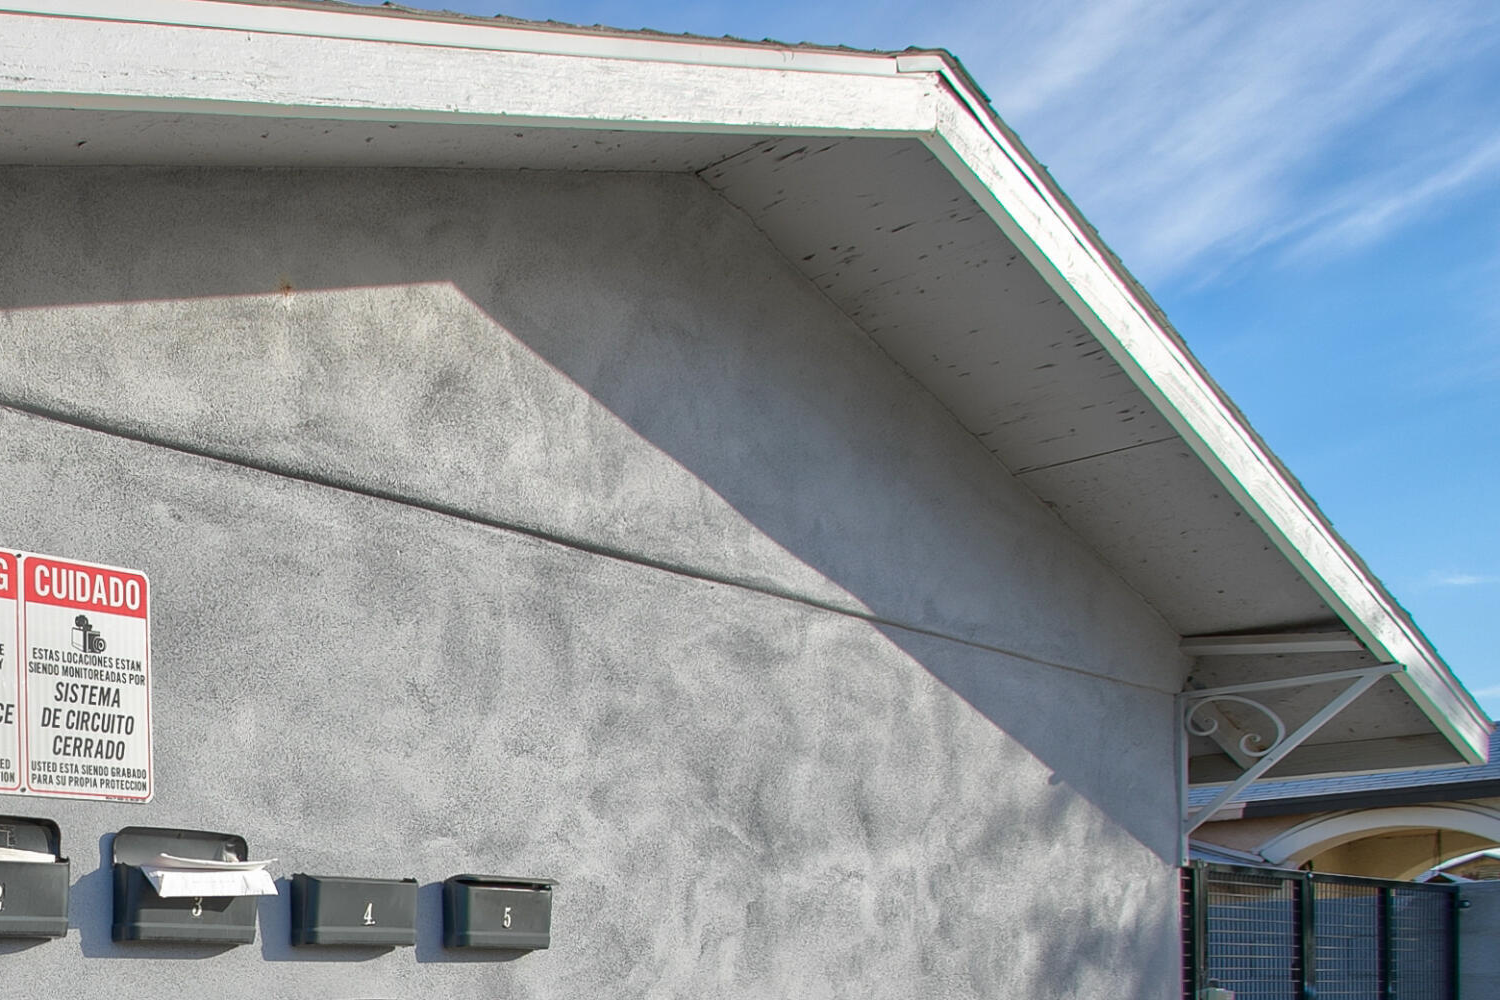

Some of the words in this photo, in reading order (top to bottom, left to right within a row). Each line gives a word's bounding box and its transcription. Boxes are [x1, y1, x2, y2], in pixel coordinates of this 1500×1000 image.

[34, 564, 141, 611] CUIDADO
[32, 647, 60, 662] ESTAS
[62, 651, 114, 669] LOCACIONES
[116, 658, 142, 672] ESTAN
[28, 661, 59, 676] SIENDO
[61, 665, 127, 684] MONITOREADAS
[129, 673, 145, 686] POR
[54, 681, 121, 709] SISTEMA
[41, 707, 61, 728] DE
[66, 709, 134, 736] CIRCUITO
[52, 735, 126, 761] CERRADO
[31, 760, 57, 773] USTED
[59, 762, 79, 774] ESTA
[81, 764, 109, 776] SIENDO
[111, 766, 147, 780] GRABADO
[31, 773, 53, 785] PARA
[56, 775, 66, 786] SU
[68, 776, 98, 788] PROPIA
[100, 778, 147, 792] PROTECCION
[363, 903, 376, 926] 4
[502, 907, 512, 928] 5
